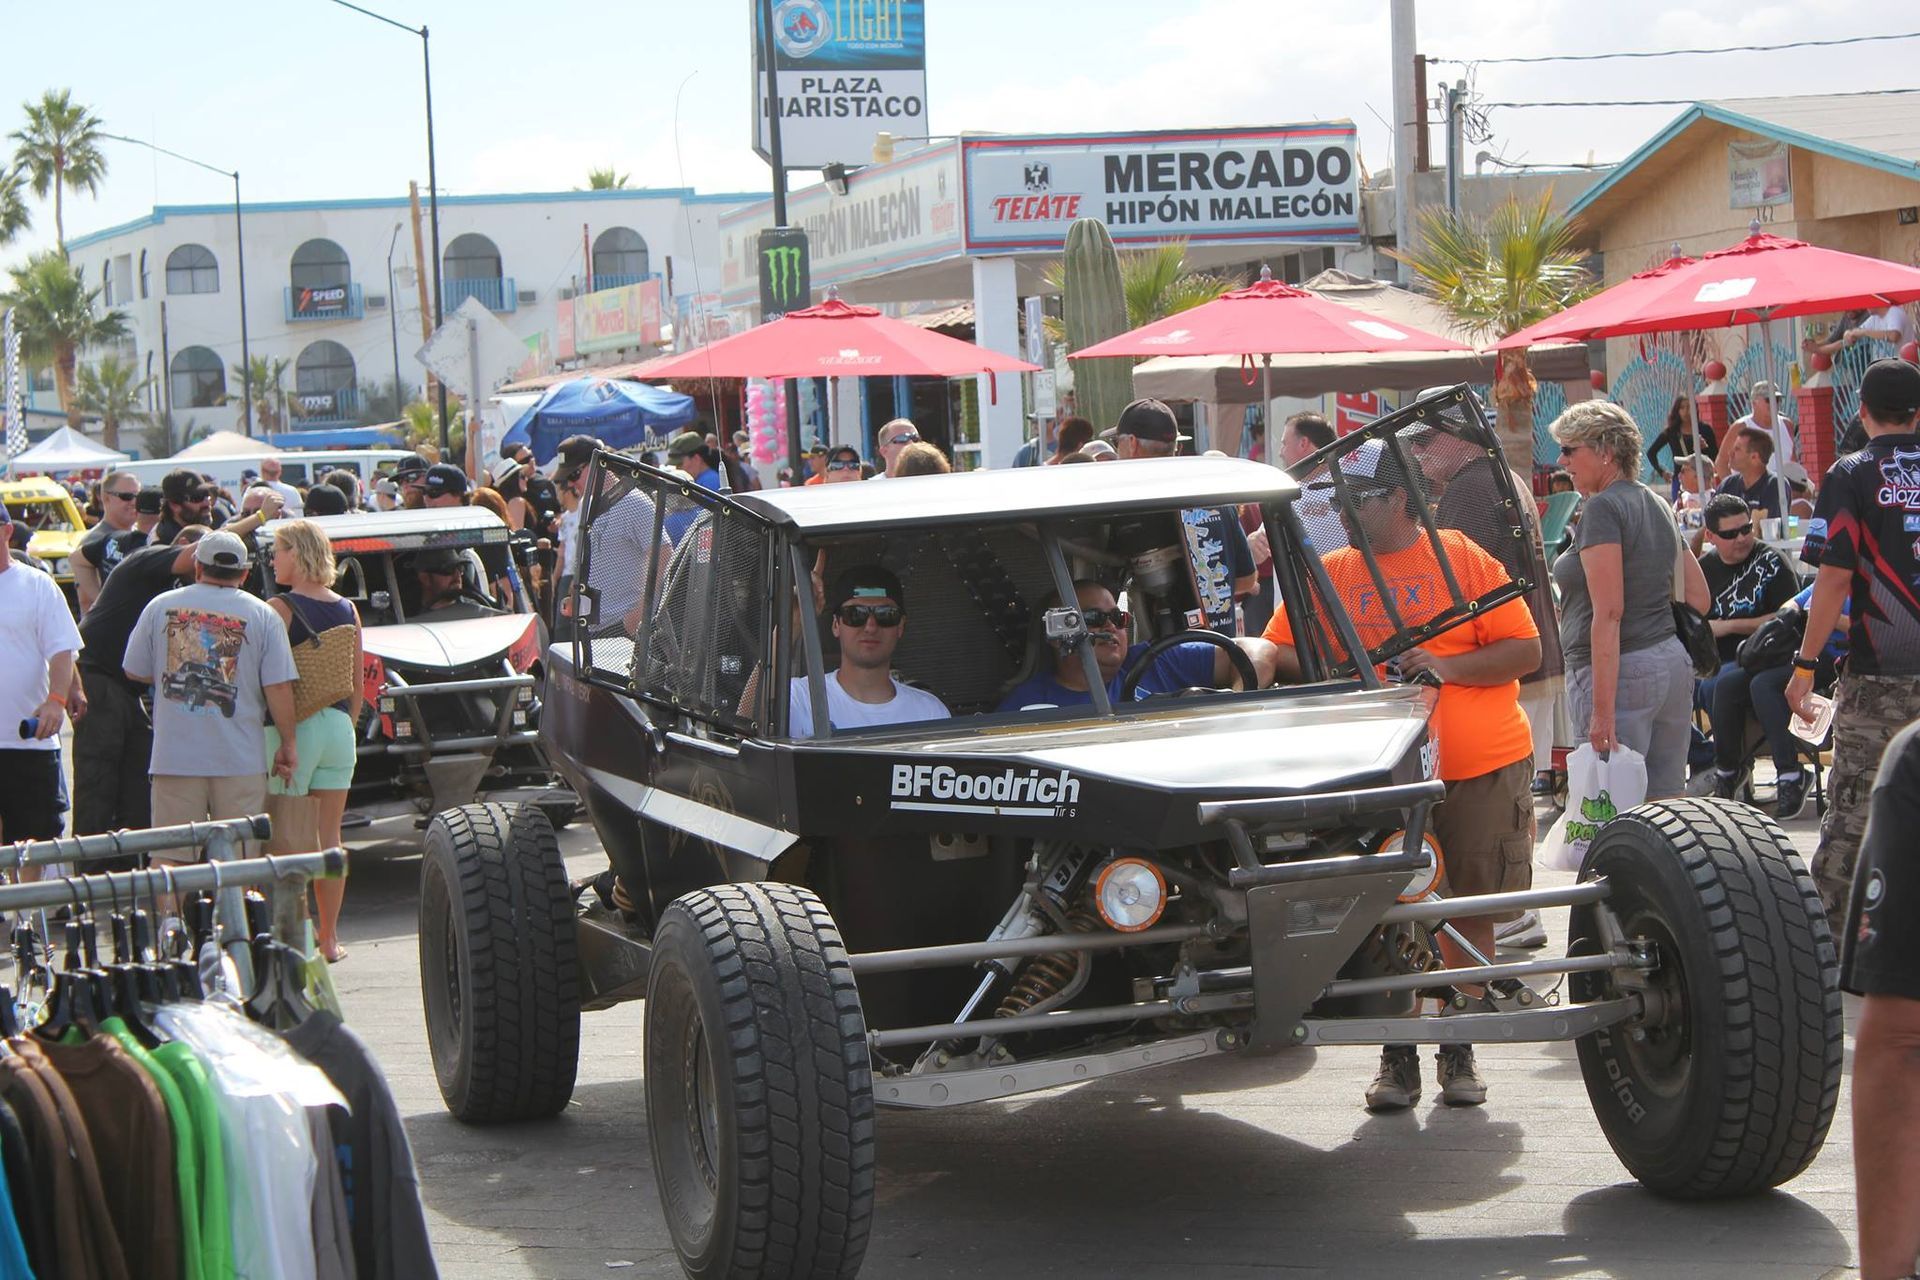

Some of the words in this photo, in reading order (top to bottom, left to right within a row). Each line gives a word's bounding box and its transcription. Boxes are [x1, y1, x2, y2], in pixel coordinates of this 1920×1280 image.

[801, 78, 882, 94] PLAZA
[1103, 147, 1353, 194] MERCADO
[851, 178, 921, 249] MALECÓN
[993, 195, 1082, 222] TECATE
[1106, 194, 1200, 225] HIPÓN
[1210, 189, 1353, 221] MALECÓN
[312, 289, 345, 302] SPEED
[1360, 584, 1421, 616] FX
[891, 764, 1081, 804] BFGoodrich
